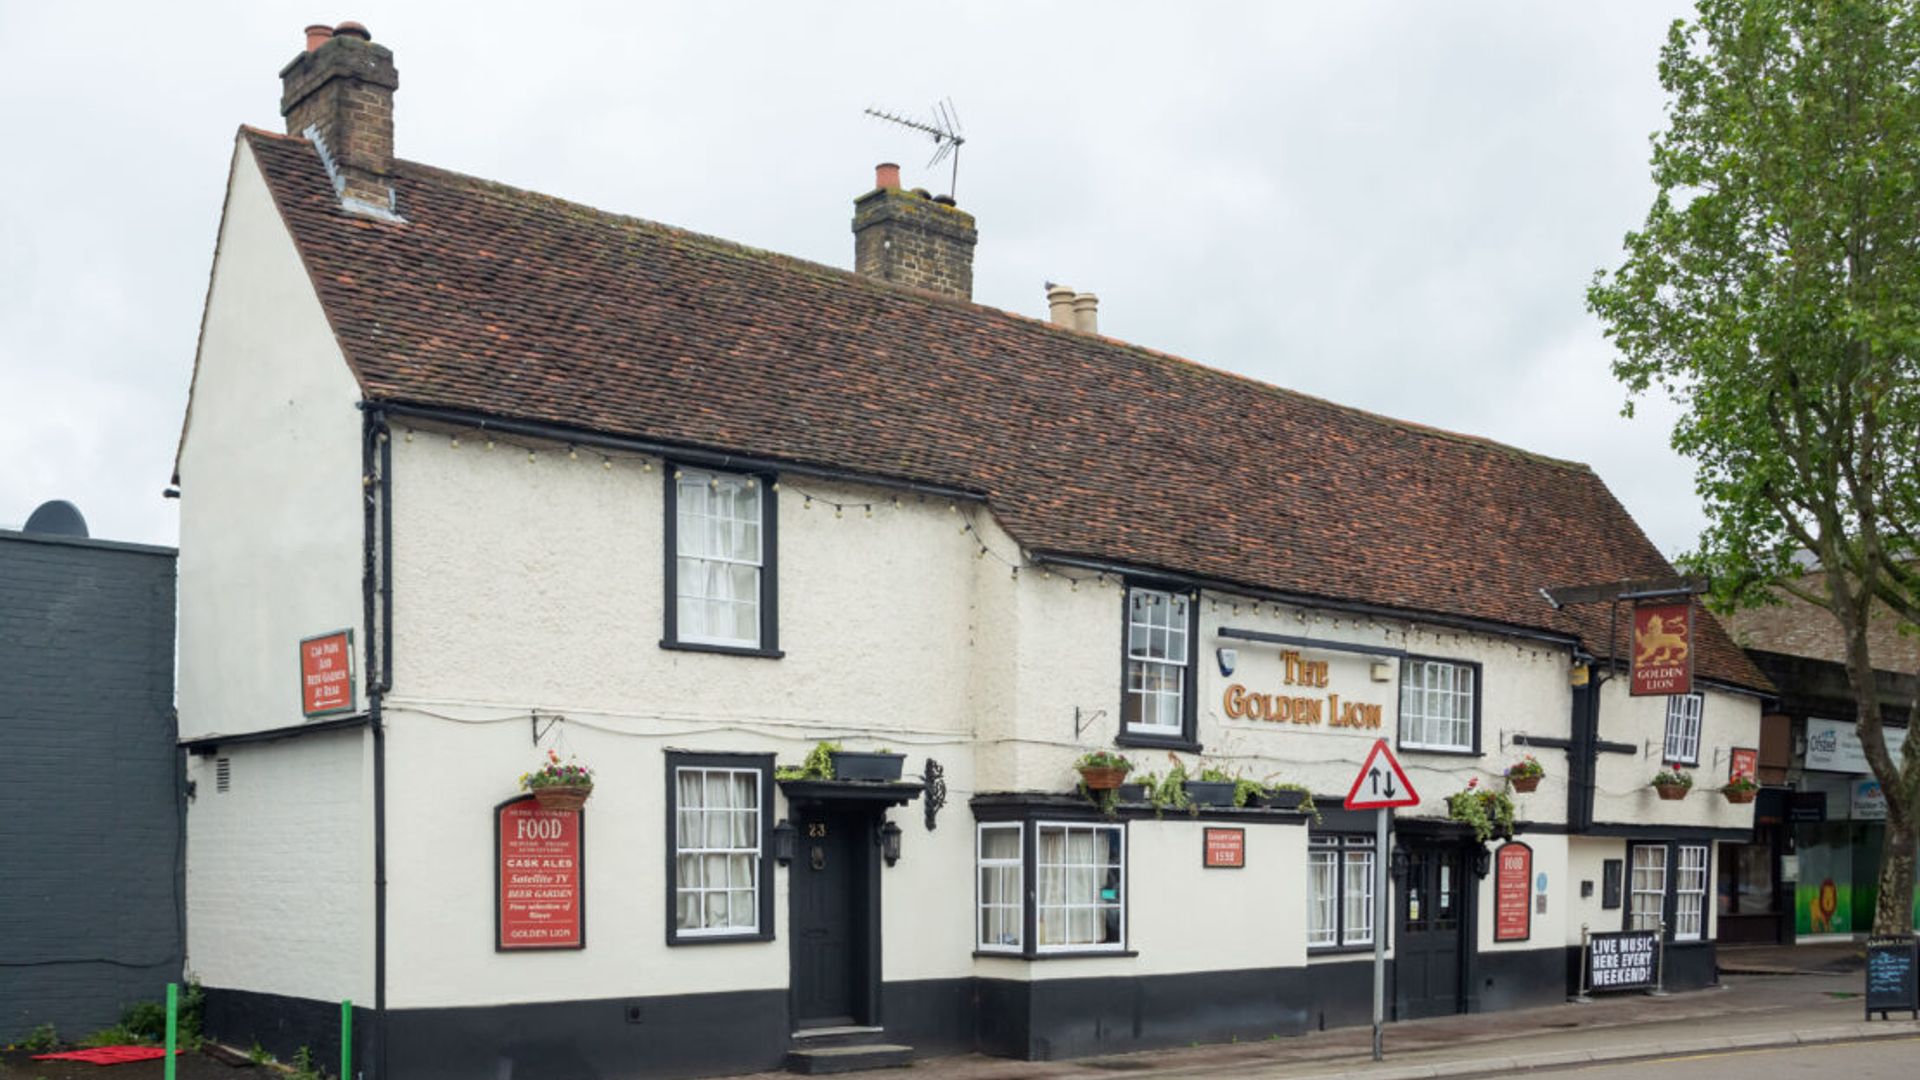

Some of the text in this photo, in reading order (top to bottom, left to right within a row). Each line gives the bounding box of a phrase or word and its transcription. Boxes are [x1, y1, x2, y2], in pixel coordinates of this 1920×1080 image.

[1280, 649, 1329, 688] THE
[1637, 667, 1683, 679] GOLDEN
[1646, 679, 1674, 690] LION
[1223, 683, 1382, 729] GOLDEN LION
[517, 818, 562, 839] FOOD
[808, 823, 825, 837] 23
[506, 859, 573, 868] CASK ALES
[511, 873, 569, 884] Satellite TV
[508, 889, 572, 898] BEER GARDEN
[511, 928, 571, 938] GOLDEN LION
[1592, 936, 1653, 954] LIVE MUSIC
[1592, 951, 1652, 969] HERE EVERY
[1592, 966, 1652, 986] WEEKEND!
